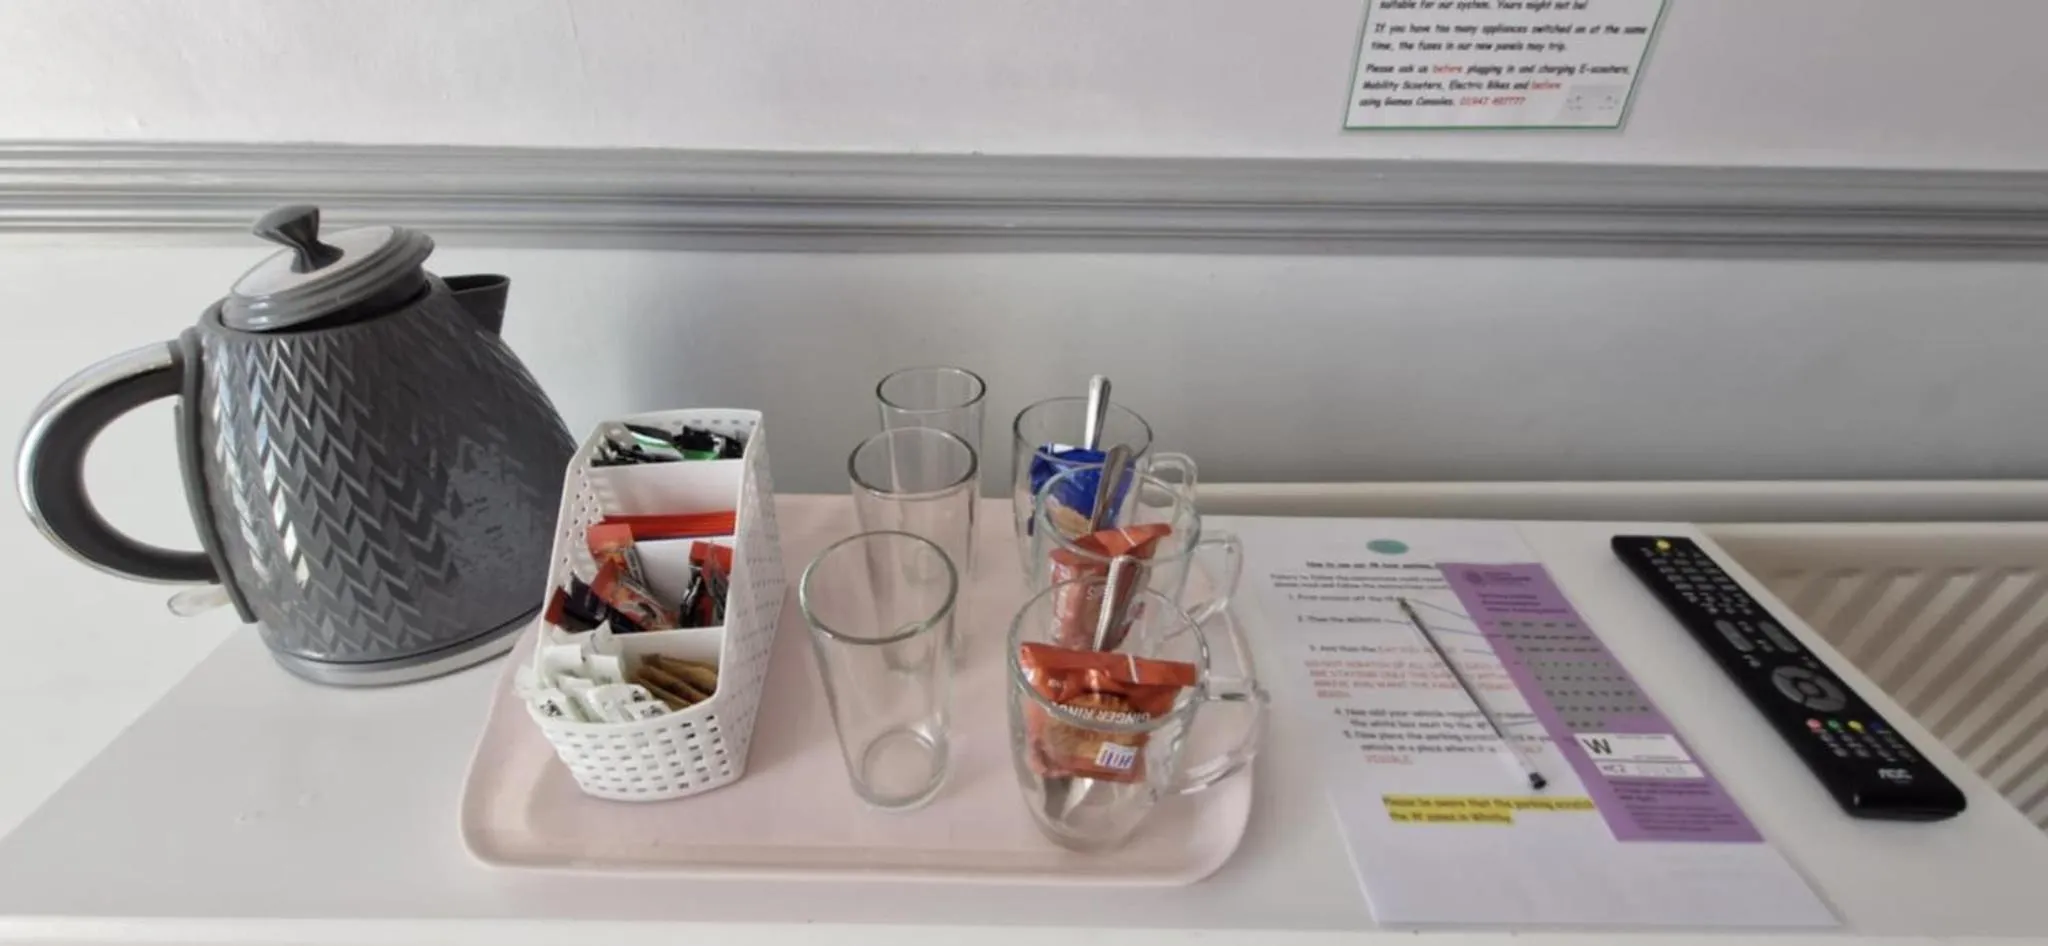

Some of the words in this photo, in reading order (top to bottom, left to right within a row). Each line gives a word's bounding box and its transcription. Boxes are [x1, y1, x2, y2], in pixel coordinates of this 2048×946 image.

[1498, 0, 1522, 9] Yours
[1526, 0, 1551, 12] might
[1554, 0, 1570, 9] not
[1374, 23, 1386, 33] If
[1389, 25, 1406, 35] you
[1409, 23, 1431, 33] have
[1435, 23, 1451, 33] too
[1454, 25, 1478, 35] many
[1482, 25, 1528, 35] appliances
[1532, 24, 1573, 34] switched
[1575, 26, 1587, 34] on
[1589, 25, 1601, 34] at
[1604, 24, 1620, 34] the
[1624, 26, 1647, 34] same
[1371, 42, 1394, 51] time,
[1398, 42, 1415, 50] the
[1418, 42, 1442, 50] fuses
[1445, 42, 1454, 50] in
[1495, 42, 1524, 52] panels
[1526, 43, 1545, 53] may
[1549, 42, 1568, 53] trip.
[1366, 64, 1395, 73] Please
[1398, 65, 1414, 73] ask
[1433, 64, 1462, 73] before
[1466, 65, 1503, 75] plugging
[1506, 65, 1515, 73] in
[1518, 65, 1536, 74] and
[1538, 65, 1576, 76] charging
[1363, 81, 1399, 92] Mobility
[1402, 81, 1445, 91] Scooters,
[1449, 81, 1483, 90] Electric
[1487, 81, 1510, 90] Bikes
[1513, 81, 1530, 90] and
[1531, 81, 1562, 90] before
[1359, 97, 1381, 108] using
[1384, 97, 1413, 106] Games
[1416, 97, 1454, 106] Consoles.
[1096, 707, 1151, 725] GINGER
[1581, 738, 1612, 754] W
